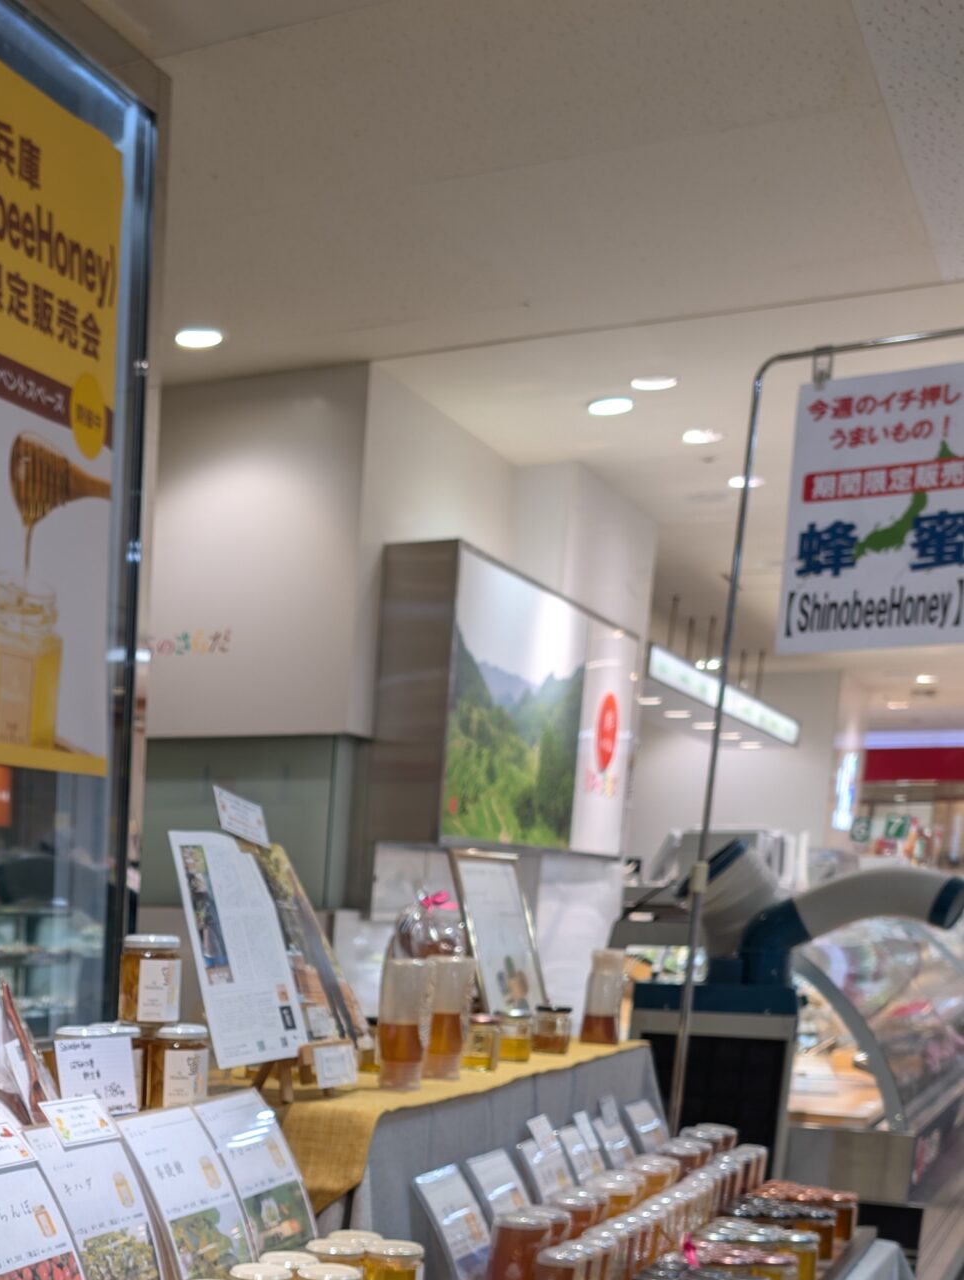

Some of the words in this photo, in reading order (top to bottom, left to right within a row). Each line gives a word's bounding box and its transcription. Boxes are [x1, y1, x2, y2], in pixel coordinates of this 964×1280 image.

[808, 383, 961, 421] 今週のイチ押し
[785, 578, 964, 638] 【ShinobeeHoney】
